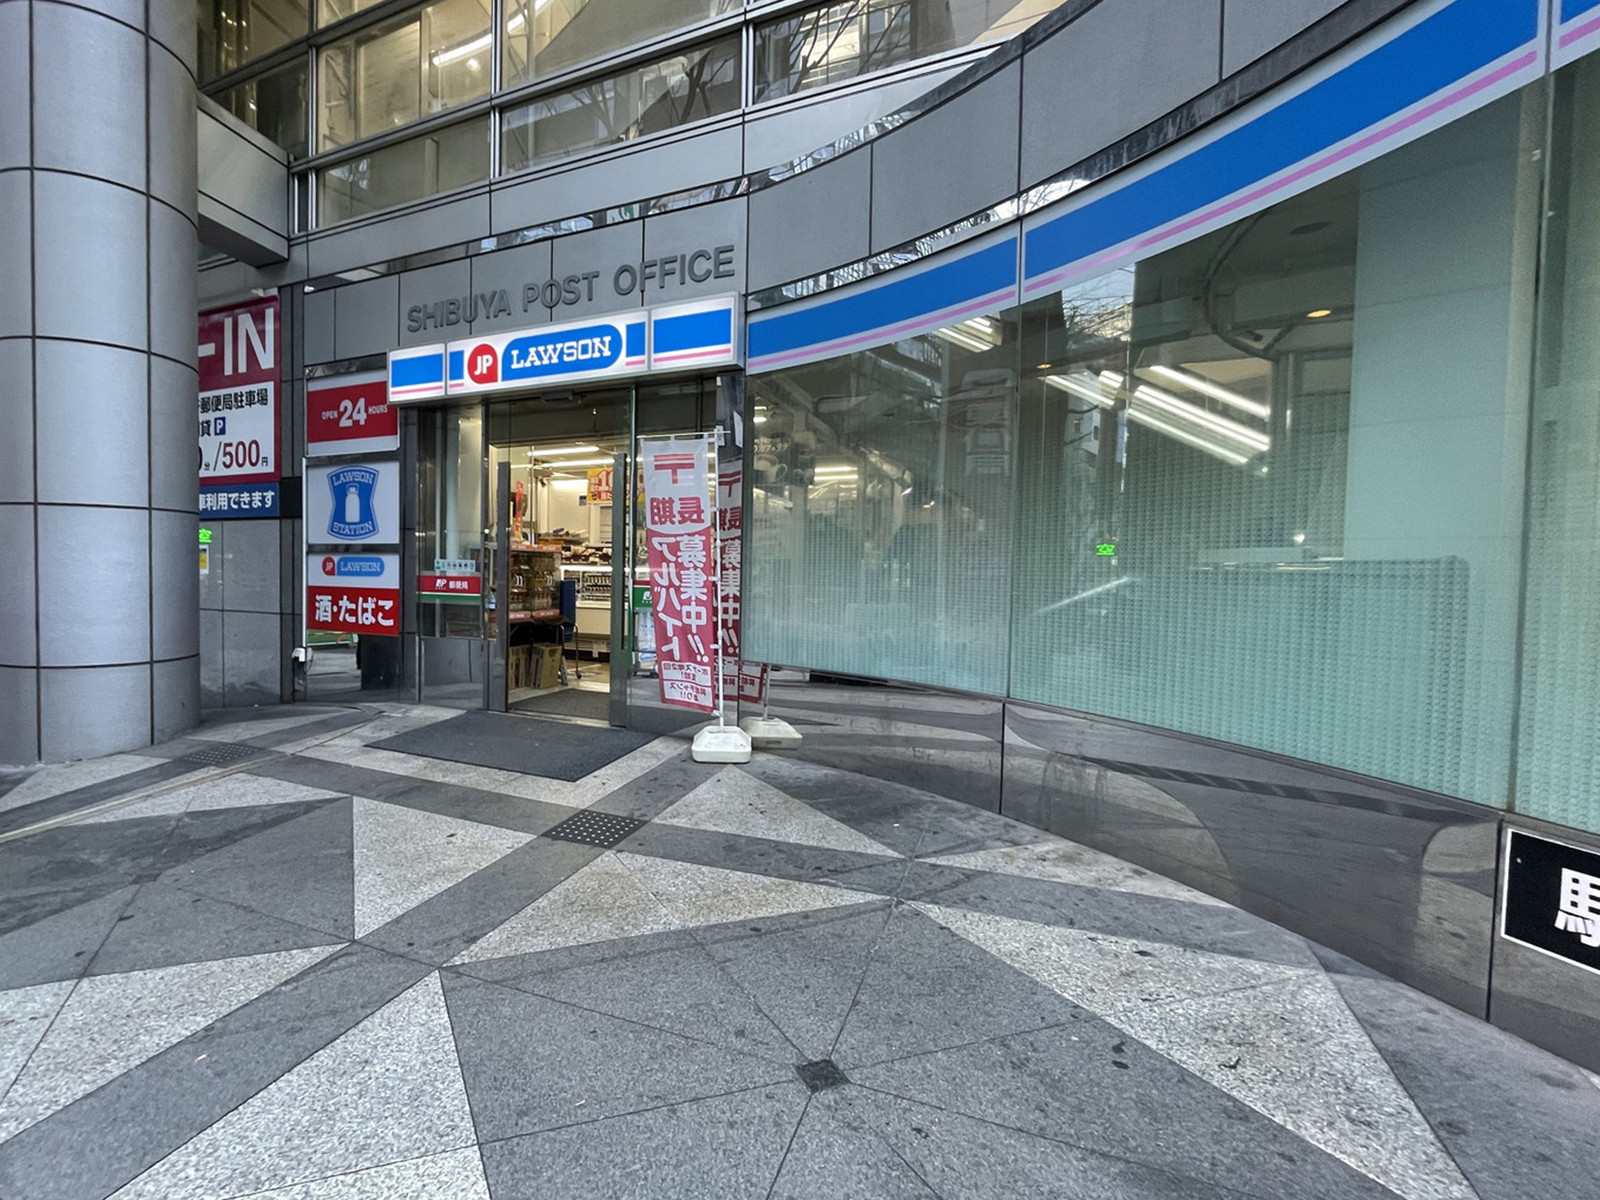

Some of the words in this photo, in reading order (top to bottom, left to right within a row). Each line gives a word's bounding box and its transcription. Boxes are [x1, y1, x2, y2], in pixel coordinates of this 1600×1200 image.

[407, 289, 512, 333] SHIBUYA
[523, 271, 600, 312] POST
[613, 245, 736, 296] OFFICE
[474, 355, 494, 376] JP
[511, 336, 612, 370] LAWSON
[198, 388, 269, 414] 郵便局駐車場
[322, 410, 339, 420] OPEN
[339, 397, 367, 427] 24
[368, 403, 388, 416] HOURS
[199, 420, 212, 437] 貸
[332, 470, 375, 485] LAWSON
[333, 522, 375, 535] STATION
[340, 560, 381, 573] LAWSON
